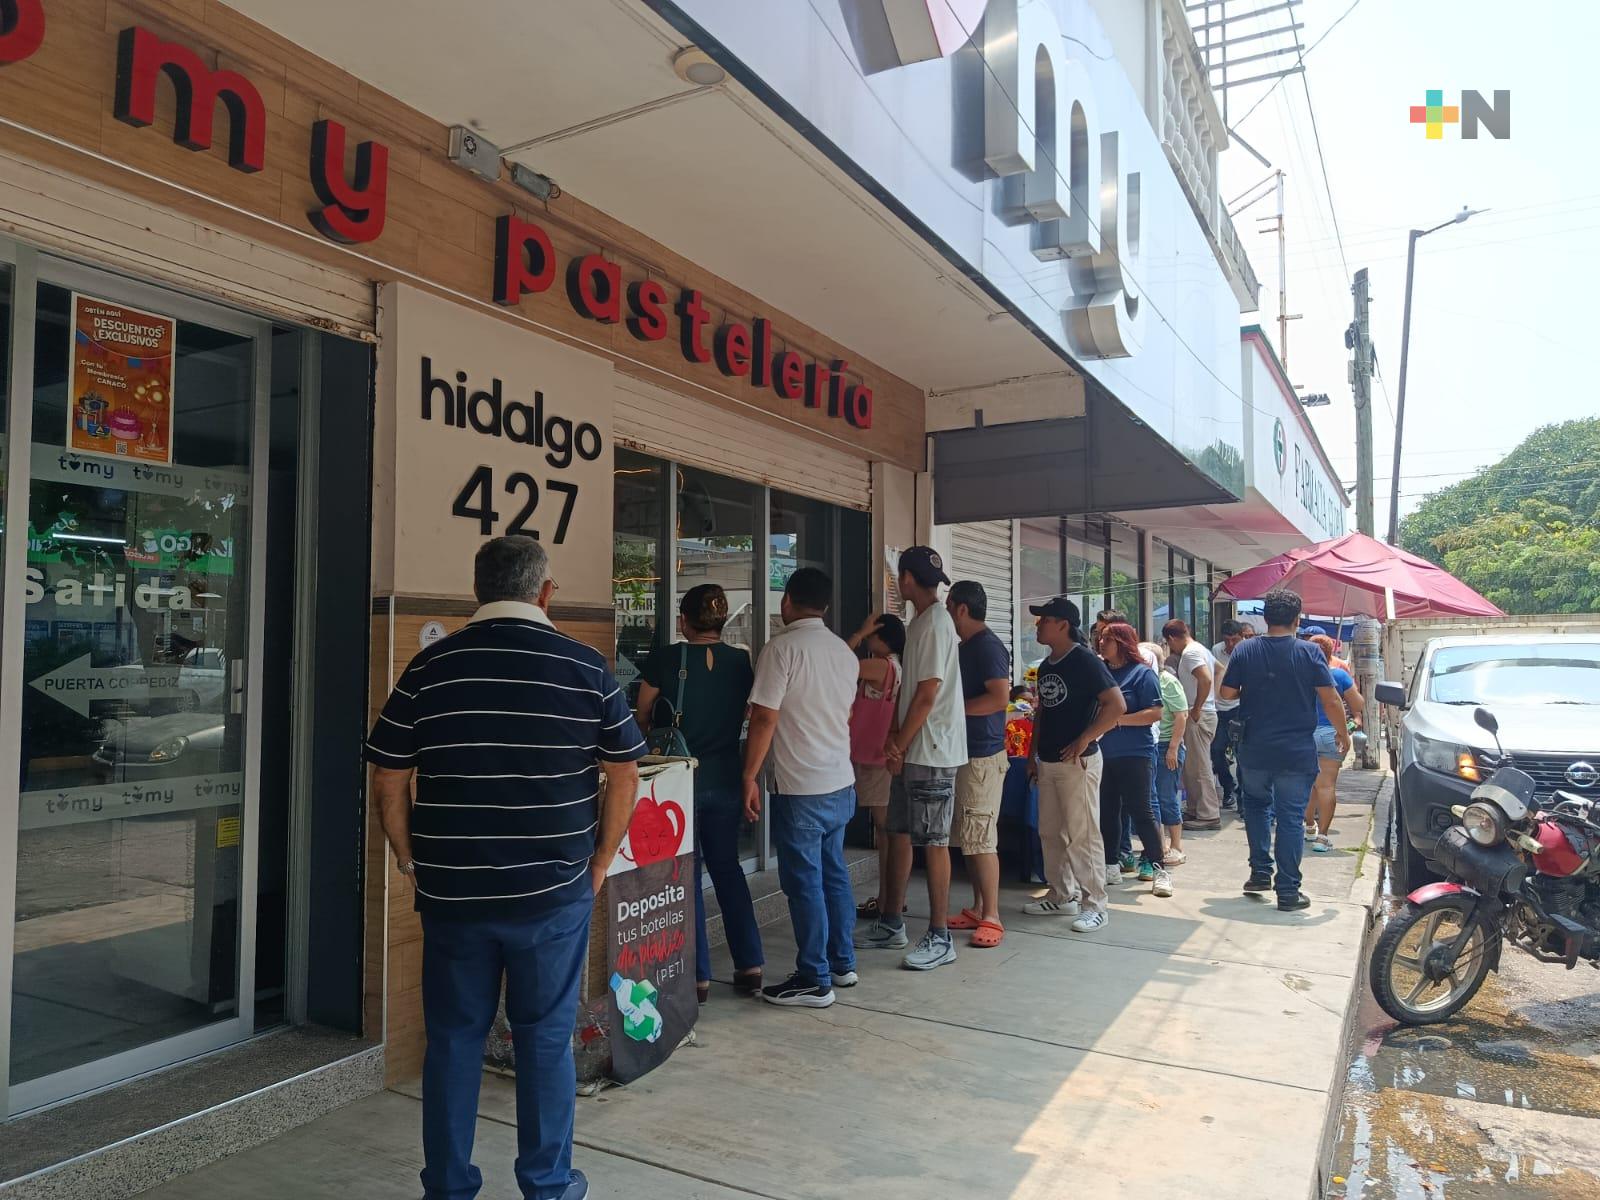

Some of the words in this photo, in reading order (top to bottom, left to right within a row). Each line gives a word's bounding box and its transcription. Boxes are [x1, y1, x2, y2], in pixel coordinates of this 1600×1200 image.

[94, 317, 162, 338] DESCUENTOS
[98, 329, 159, 348] EXCLUSIVOS
[493, 213, 874, 430] pastelería
[97, 377, 127, 389] CANACO
[420, 356, 603, 469] hidalgo
[451, 464, 579, 545] 427
[26, 567, 192, 609] Salida
[44, 677, 105, 691] PUERTA
[617, 884, 685, 923] Deposita
[617, 927, 637, 945] tus
[640, 910, 684, 937] botellas
[656, 957, 684, 986] (PET)
